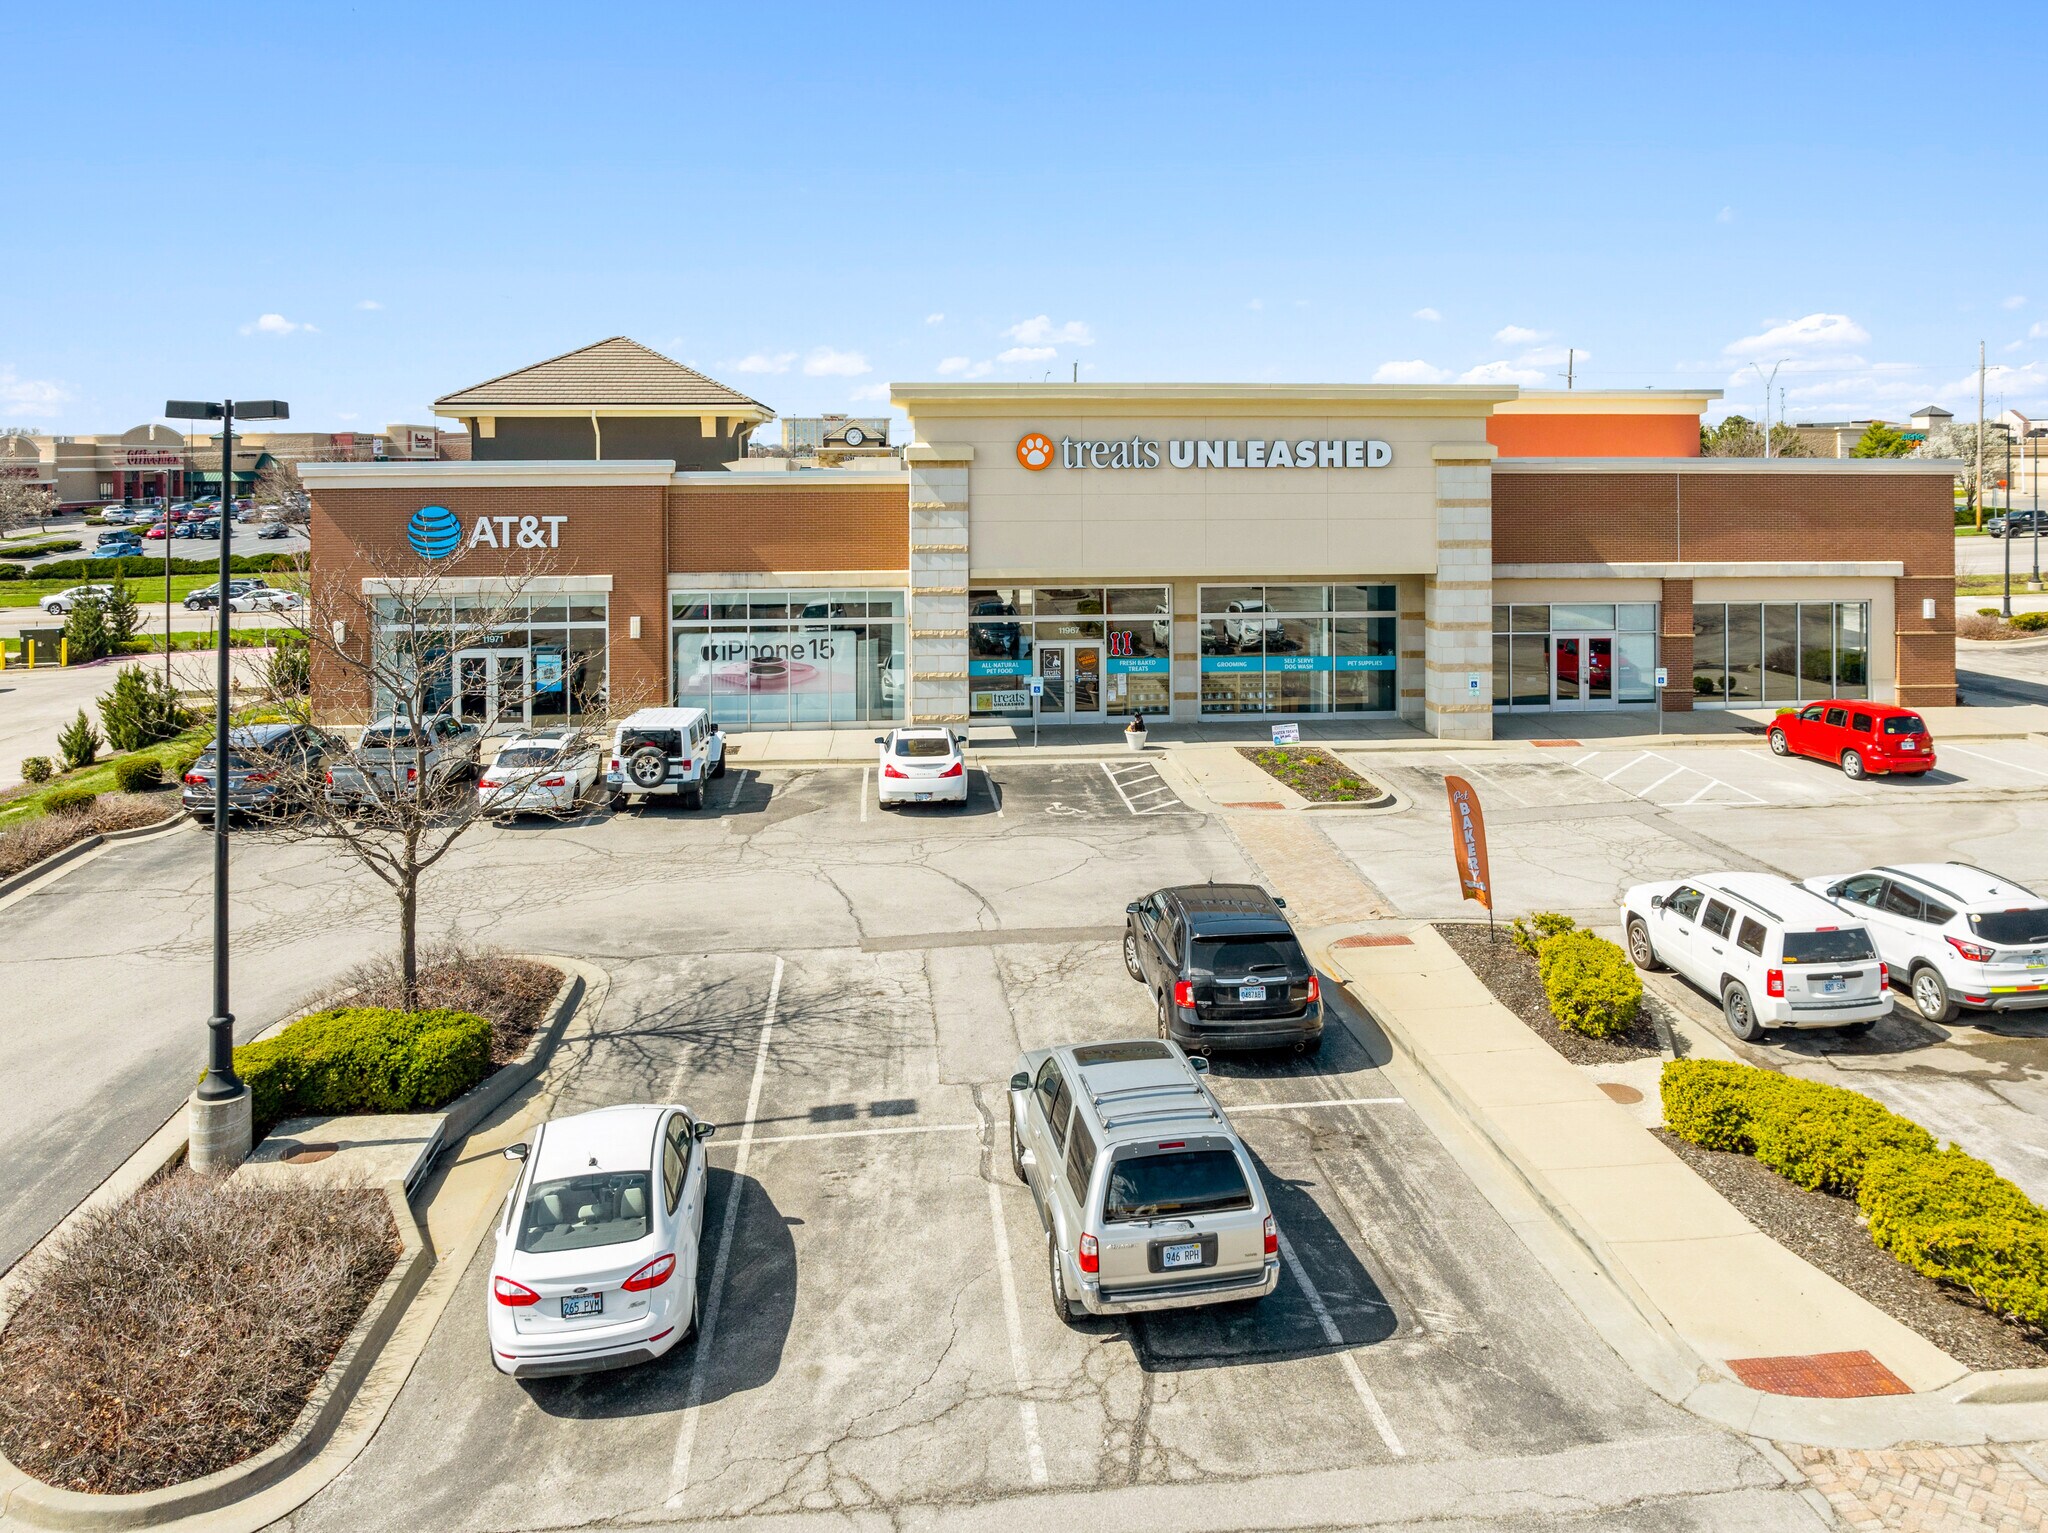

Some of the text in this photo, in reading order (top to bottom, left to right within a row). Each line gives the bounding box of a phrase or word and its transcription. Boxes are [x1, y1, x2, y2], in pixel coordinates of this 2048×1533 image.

[1061, 435, 1393, 469] treats UNLEASHED
[469, 515, 568, 549] AT&T
[483, 635, 504, 643] 11971
[722, 639, 835, 660] iPhone 15
[993, 693, 1025, 703] treats
[1453, 790, 1470, 803] Pet
[1459, 802, 1480, 882] BAKERY
[1166, 1249, 1200, 1263] 946 RPH
[564, 1301, 580, 1315] 265
[584, 1299, 600, 1312] PVM
